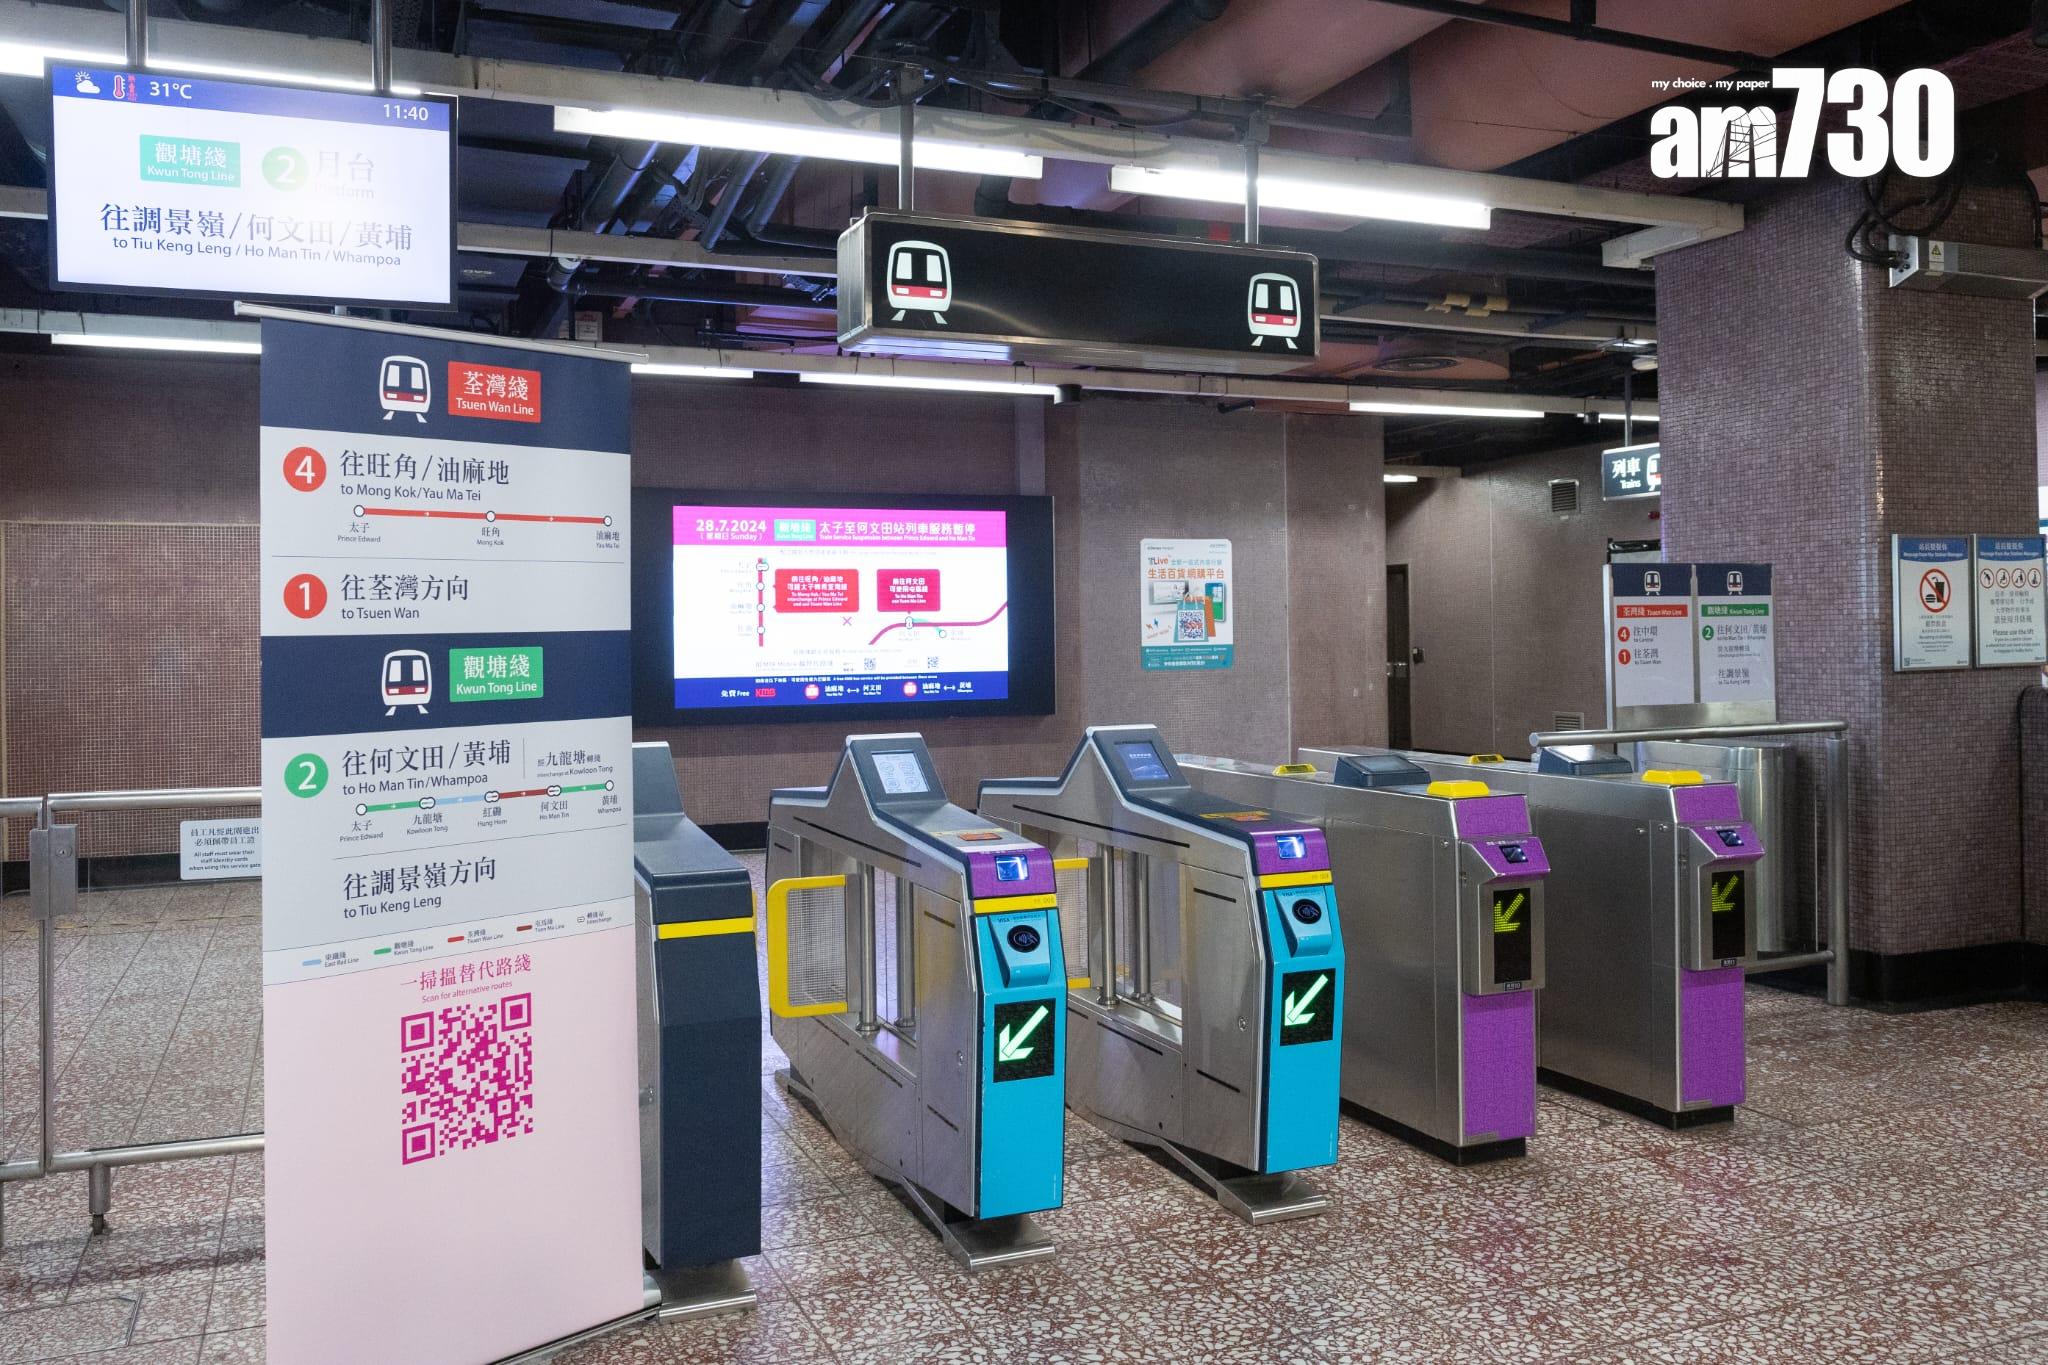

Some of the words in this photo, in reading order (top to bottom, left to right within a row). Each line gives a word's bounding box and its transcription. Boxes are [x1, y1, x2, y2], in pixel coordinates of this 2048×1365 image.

[149, 81, 192, 100] 31°C
[382, 103, 428, 121] 11:40
[154, 141, 227, 169] 觀塘綫
[147, 166, 179, 179] Kwun
[181, 168, 210, 182] Tong
[212, 170, 235, 182] Line
[276, 154, 295, 183] 2
[316, 149, 374, 184] 月台
[113, 236, 127, 249] to
[132, 237, 153, 250] Tiu
[157, 238, 193, 256] Keng
[197, 240, 231, 257] Leng
[245, 244, 264, 257] Ho
[268, 246, 298, 259] Man
[301, 248, 321, 260] Tin
[333, 250, 400, 266] Whampoa
[463, 371, 528, 400] 荃灣綫
[456, 398, 487, 412] Tsuen
[489, 401, 511, 414] Wan
[514, 403, 534, 416] Line
[294, 456, 315, 484] 4
[340, 450, 509, 485] 往旺角/油麻地
[1612, 457, 1640, 478] 列車
[341, 484, 353, 495] to
[357, 484, 391, 499] Mong
[394, 485, 443, 499] Kok/Yau
[447, 488, 463, 500] Ma
[466, 489, 481, 501] Tei
[1620, 479, 1641, 489] Trains
[349, 521, 369, 533] 太子
[482, 527, 500, 537] 旺角
[696, 520, 767, 532] 28.7.2024
[298, 582, 311, 611] 1
[340, 574, 468, 602] 往荃灣方向
[342, 608, 354, 619] to
[357, 607, 392, 619] Tsuen
[394, 607, 419, 619] Wan
[1621, 629, 1627, 639] 4
[1705, 628, 1711, 638] 2
[1622, 652, 1626, 662] 1
[464, 655, 529, 679] 觀塘綫
[456, 683, 485, 695] Kwun
[488, 682, 512, 696] Tong
[515, 681, 537, 693] Line
[342, 740, 510, 776] 往何文田/黃埔
[298, 762, 317, 790] 2
[570, 767, 597, 775] Kowloon
[343, 785, 355, 795] to
[360, 783, 375, 793] Ho
[380, 781, 404, 792] Man
[408, 773, 488, 789] Tin/Whampoa
[541, 801, 568, 812] 何文田
[602, 795, 618, 805] 黃埔
[352, 820, 372, 832] 太子
[414, 813, 442, 824] 九龍塘
[478, 820, 493, 828] Hung
[361, 832, 383, 840] Edward
[407, 826, 432, 835] Kowloon
[344, 856, 496, 901] 往調景嶺方向
[344, 907, 357, 918] to
[360, 904, 378, 917] Tiu
[380, 900, 410, 916] Keng
[413, 895, 442, 910] Leng
[400, 954, 532, 992] 一掃搵替代路綫
[422, 993, 438, 1003] Scan
[441, 992, 450, 1001] for
[453, 984, 490, 997] alternative
[491, 980, 512, 990] routes
